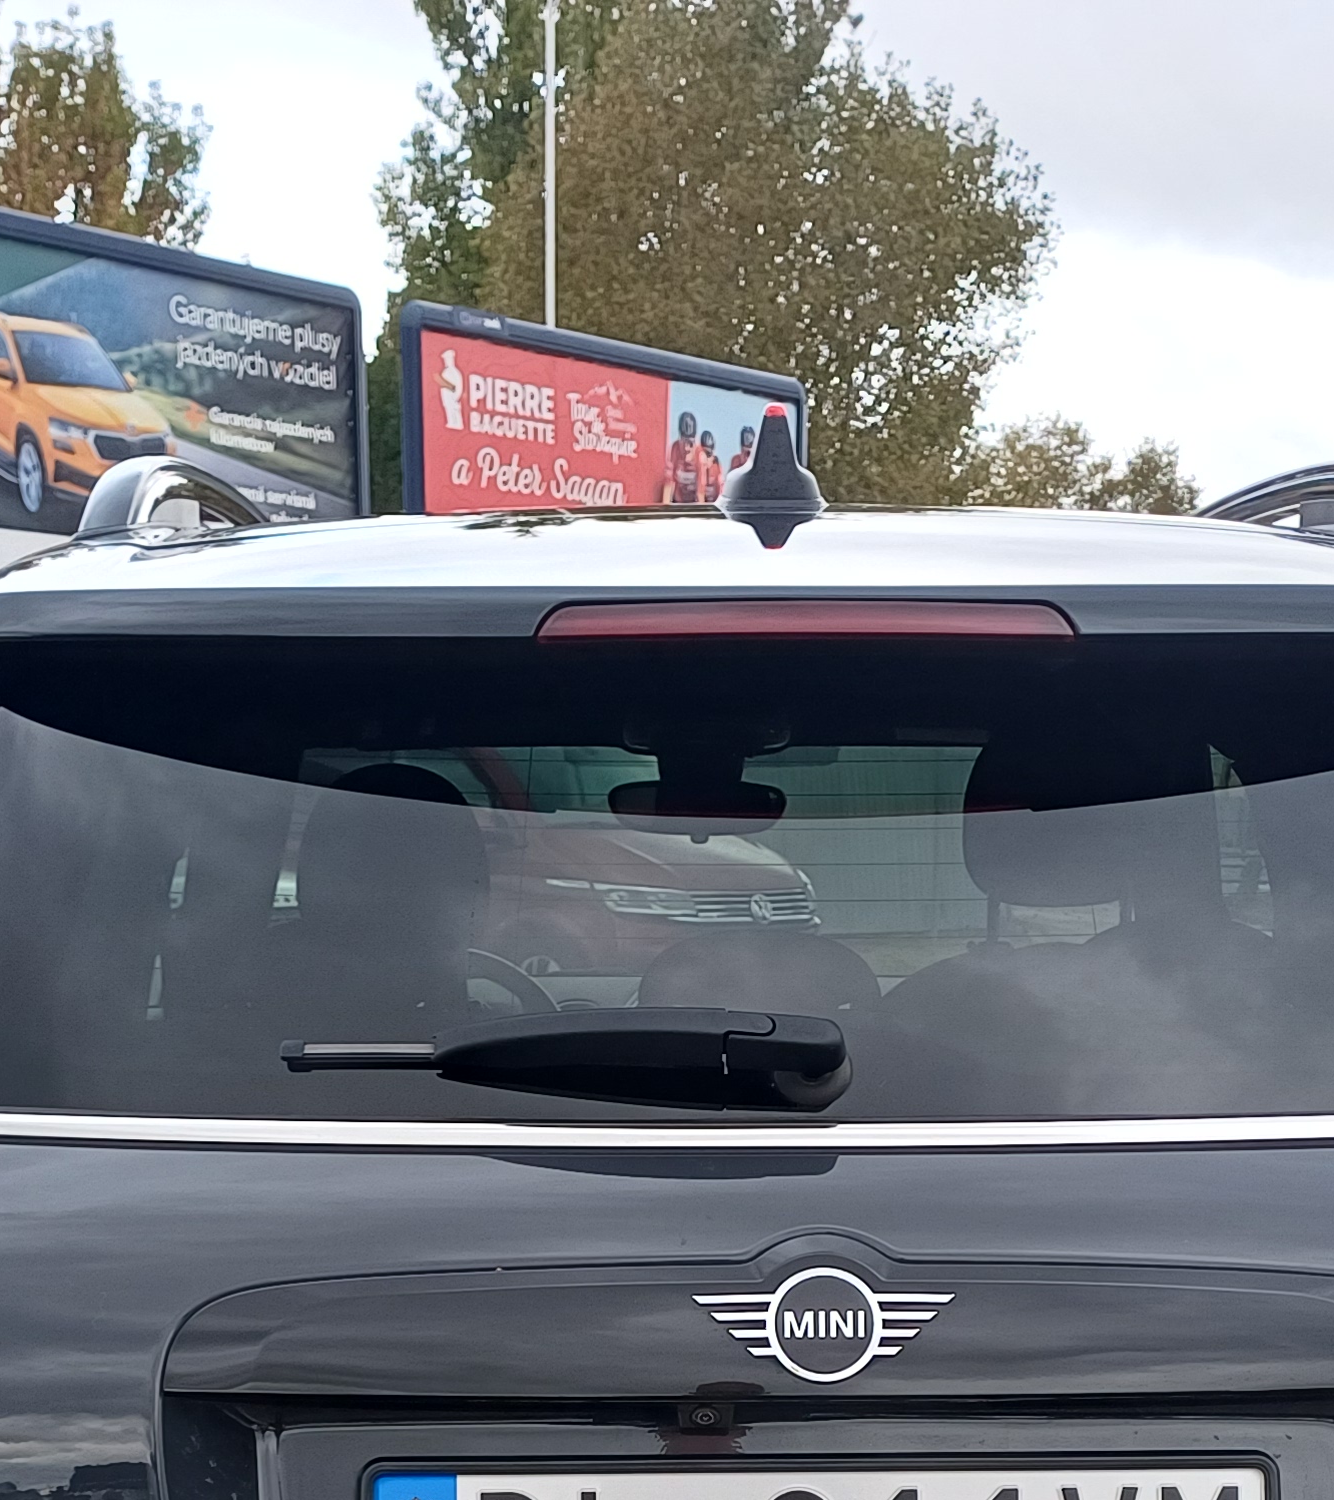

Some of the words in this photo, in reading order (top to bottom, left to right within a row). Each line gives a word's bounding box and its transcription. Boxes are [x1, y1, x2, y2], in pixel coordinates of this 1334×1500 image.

[294, 323, 341, 361] plusy
[469, 374, 555, 420] PIERRE
[469, 411, 555, 445] BAGUETTE
[451, 458, 473, 485] a
[477, 446, 547, 496] Peter
[783, 1310, 865, 1338] MINI
